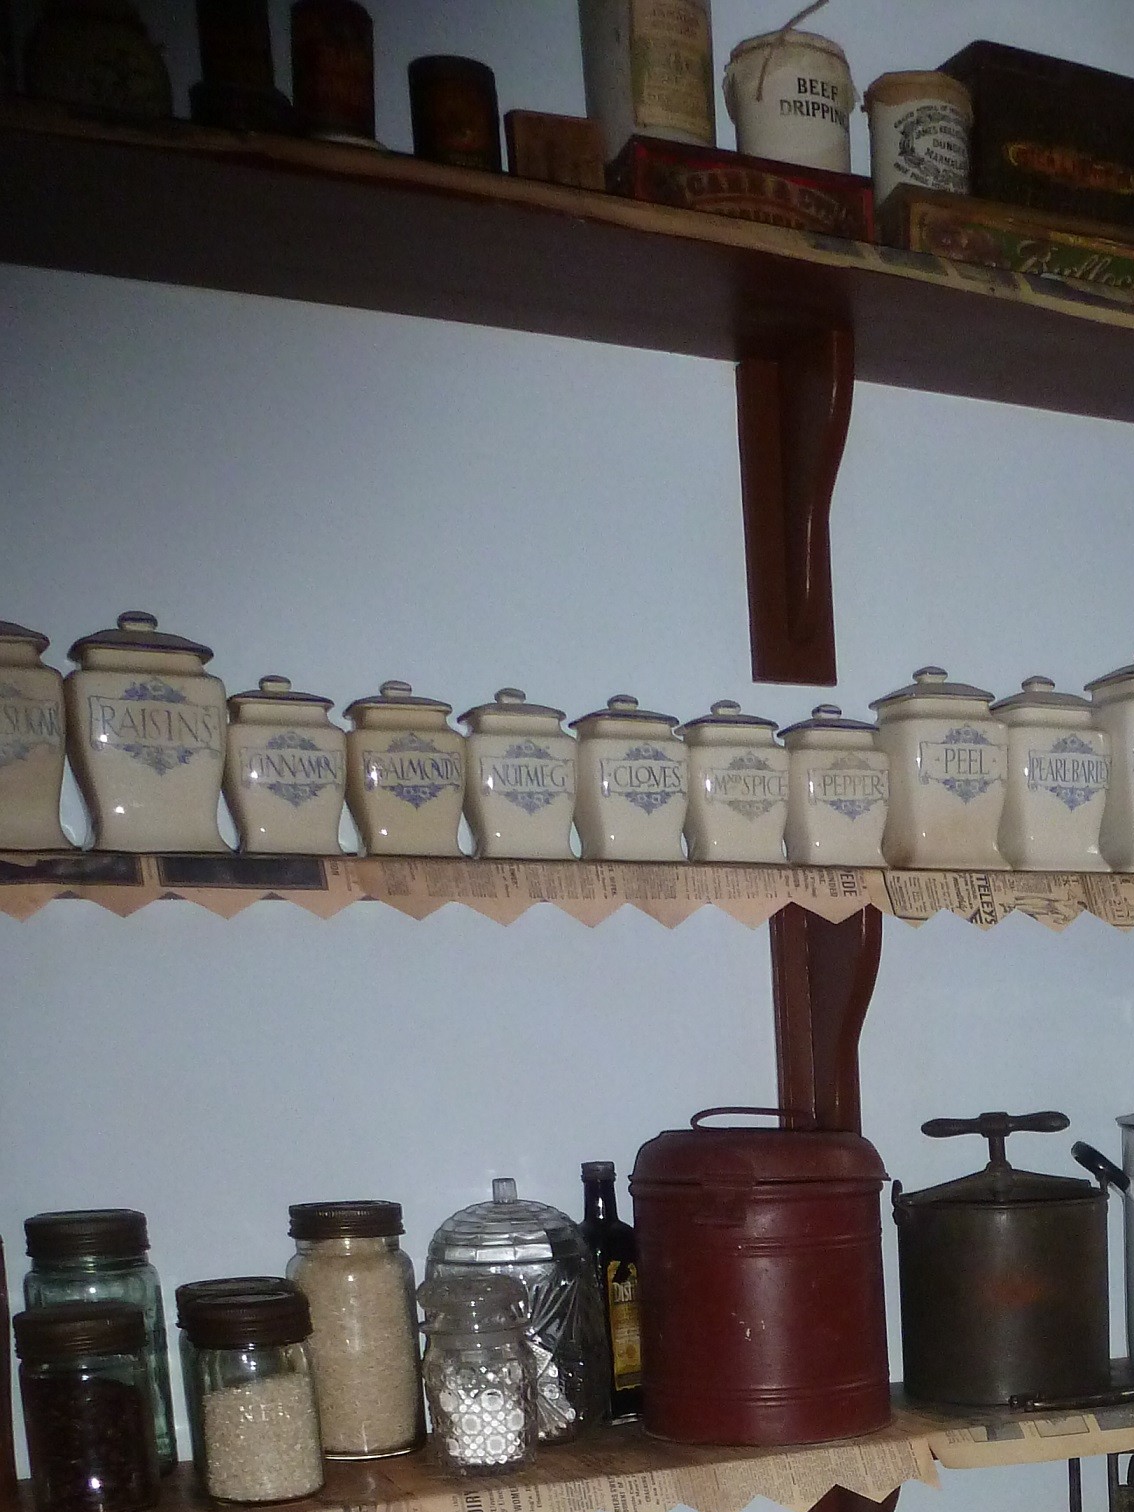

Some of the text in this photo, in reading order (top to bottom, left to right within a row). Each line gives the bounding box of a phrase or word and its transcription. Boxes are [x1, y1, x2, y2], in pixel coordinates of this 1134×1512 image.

[797, 77, 838, 101] BEEF
[100, 704, 214, 743] RAISINS
[945, 748, 989, 775] PEEL
[1031, 757, 1068, 783] PEARL
[493, 764, 565, 788] NUTMEG
[614, 765, 681, 788] CLOVES
[823, 774, 882, 798] PEPPER
